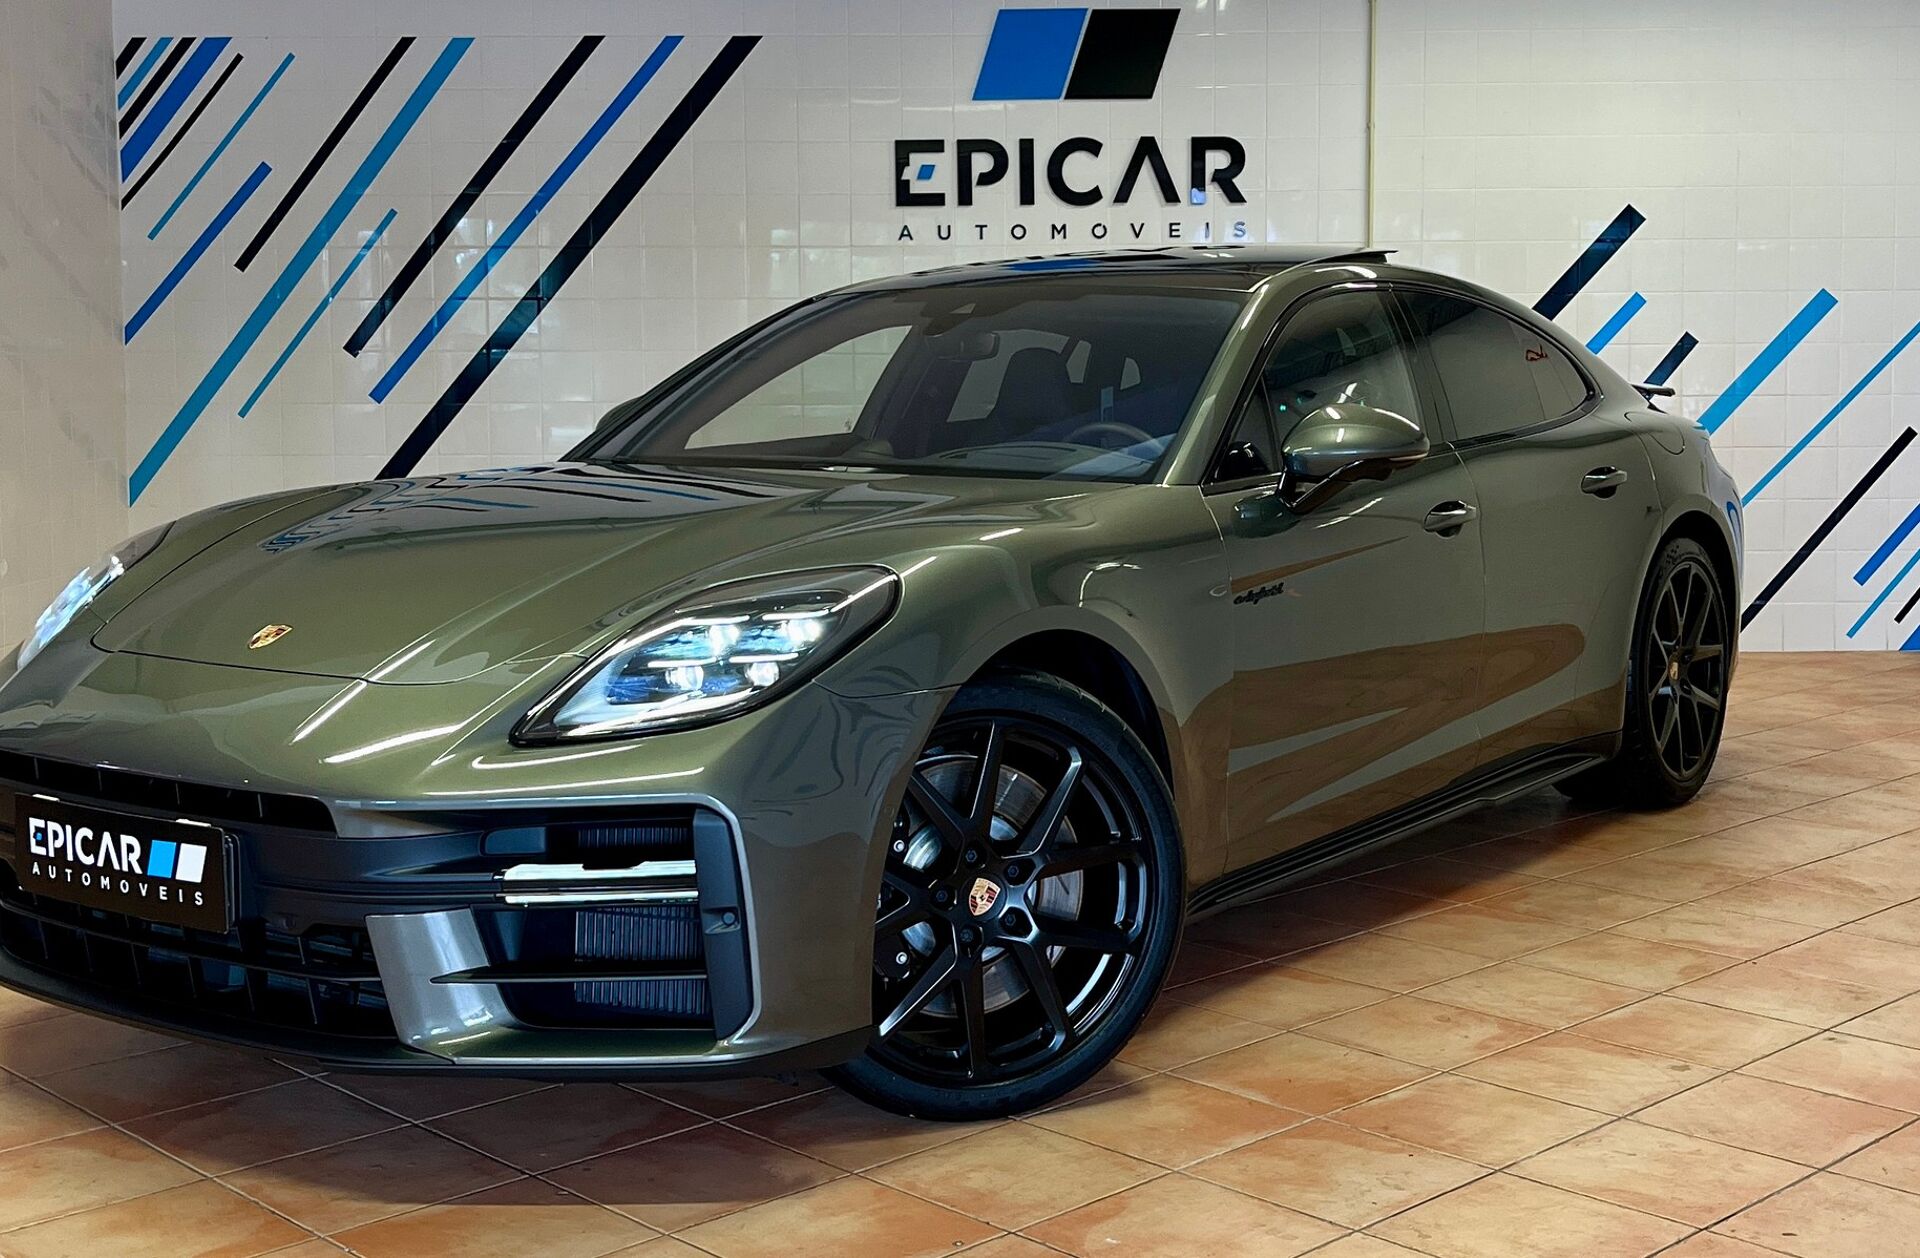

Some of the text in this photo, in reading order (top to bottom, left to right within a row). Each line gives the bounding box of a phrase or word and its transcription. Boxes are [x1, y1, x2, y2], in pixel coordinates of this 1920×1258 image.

[895, 136, 1247, 207] EPICAR
[898, 222, 1247, 241] AUTOMOVEIS
[28, 817, 143, 875] EPICAR
[32, 861, 203, 906] AUTOMOVEIS
